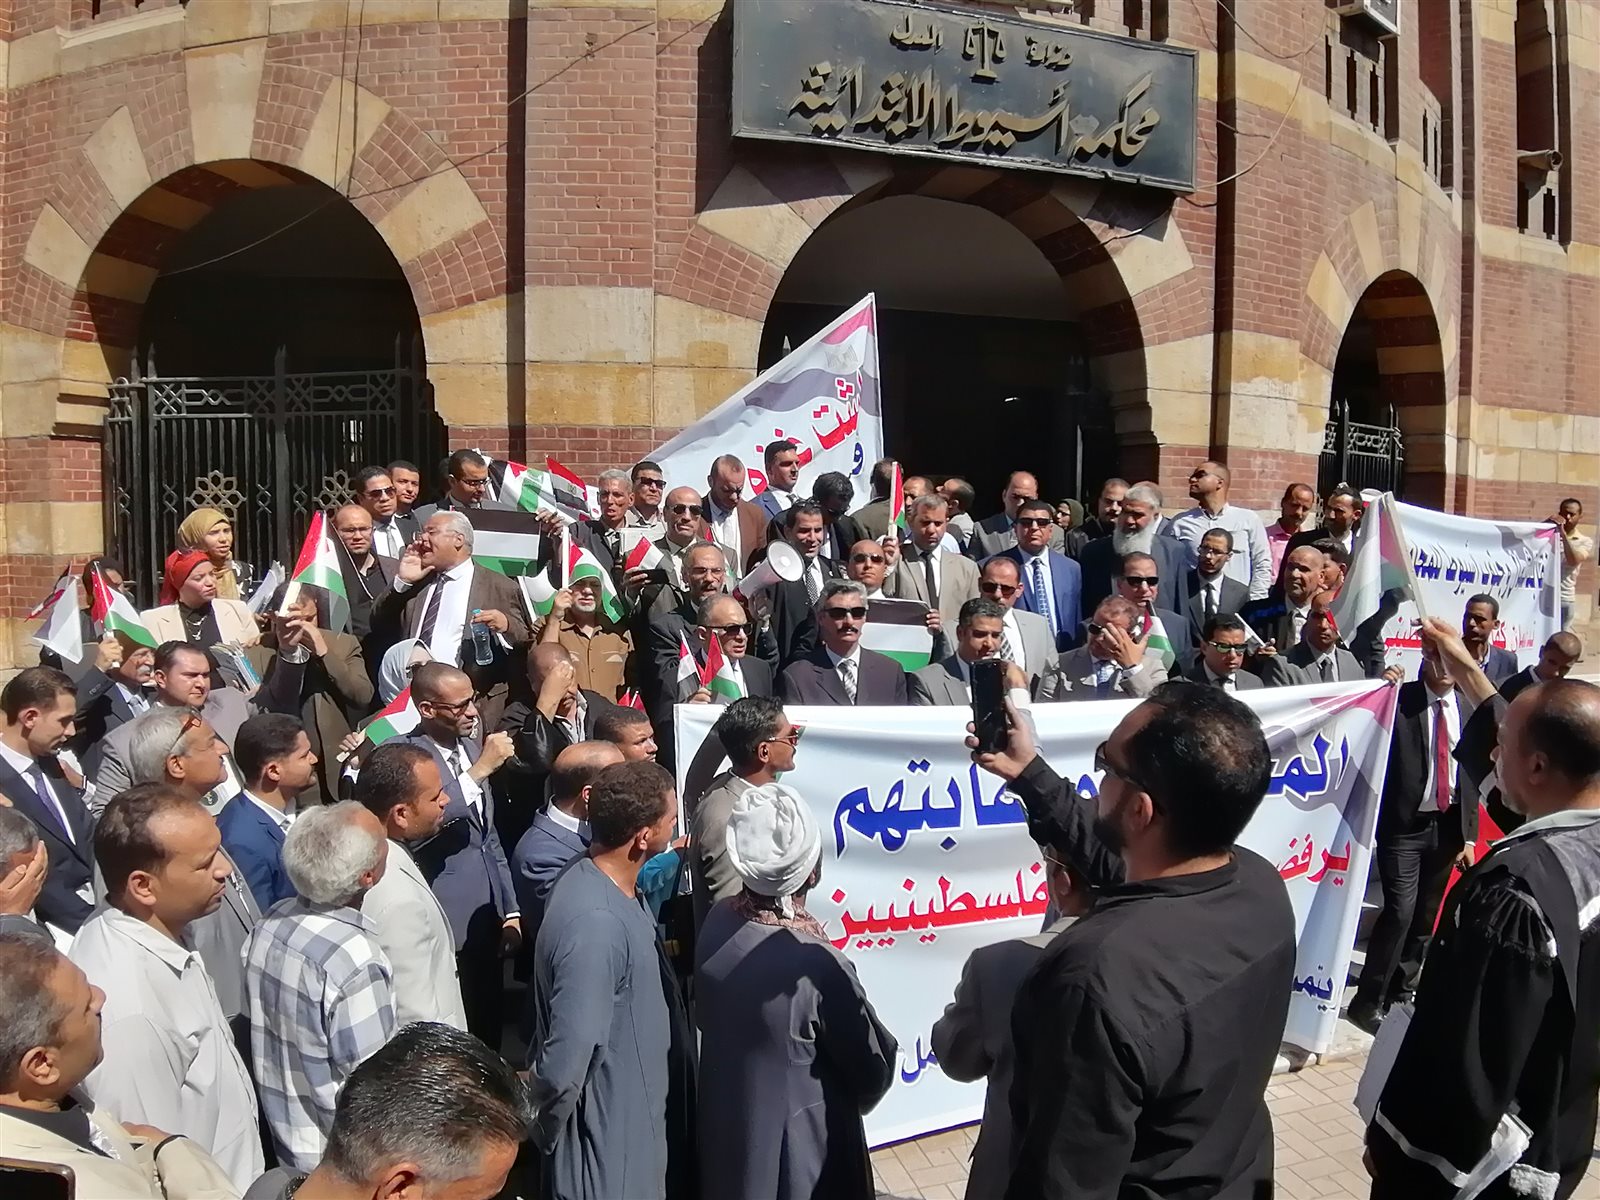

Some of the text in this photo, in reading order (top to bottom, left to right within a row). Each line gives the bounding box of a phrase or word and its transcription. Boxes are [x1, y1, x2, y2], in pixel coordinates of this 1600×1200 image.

[890, 13, 944, 51] العدل
[935, 79, 1071, 151] أسيوط
[1278, 833, 1351, 888] يرفض
